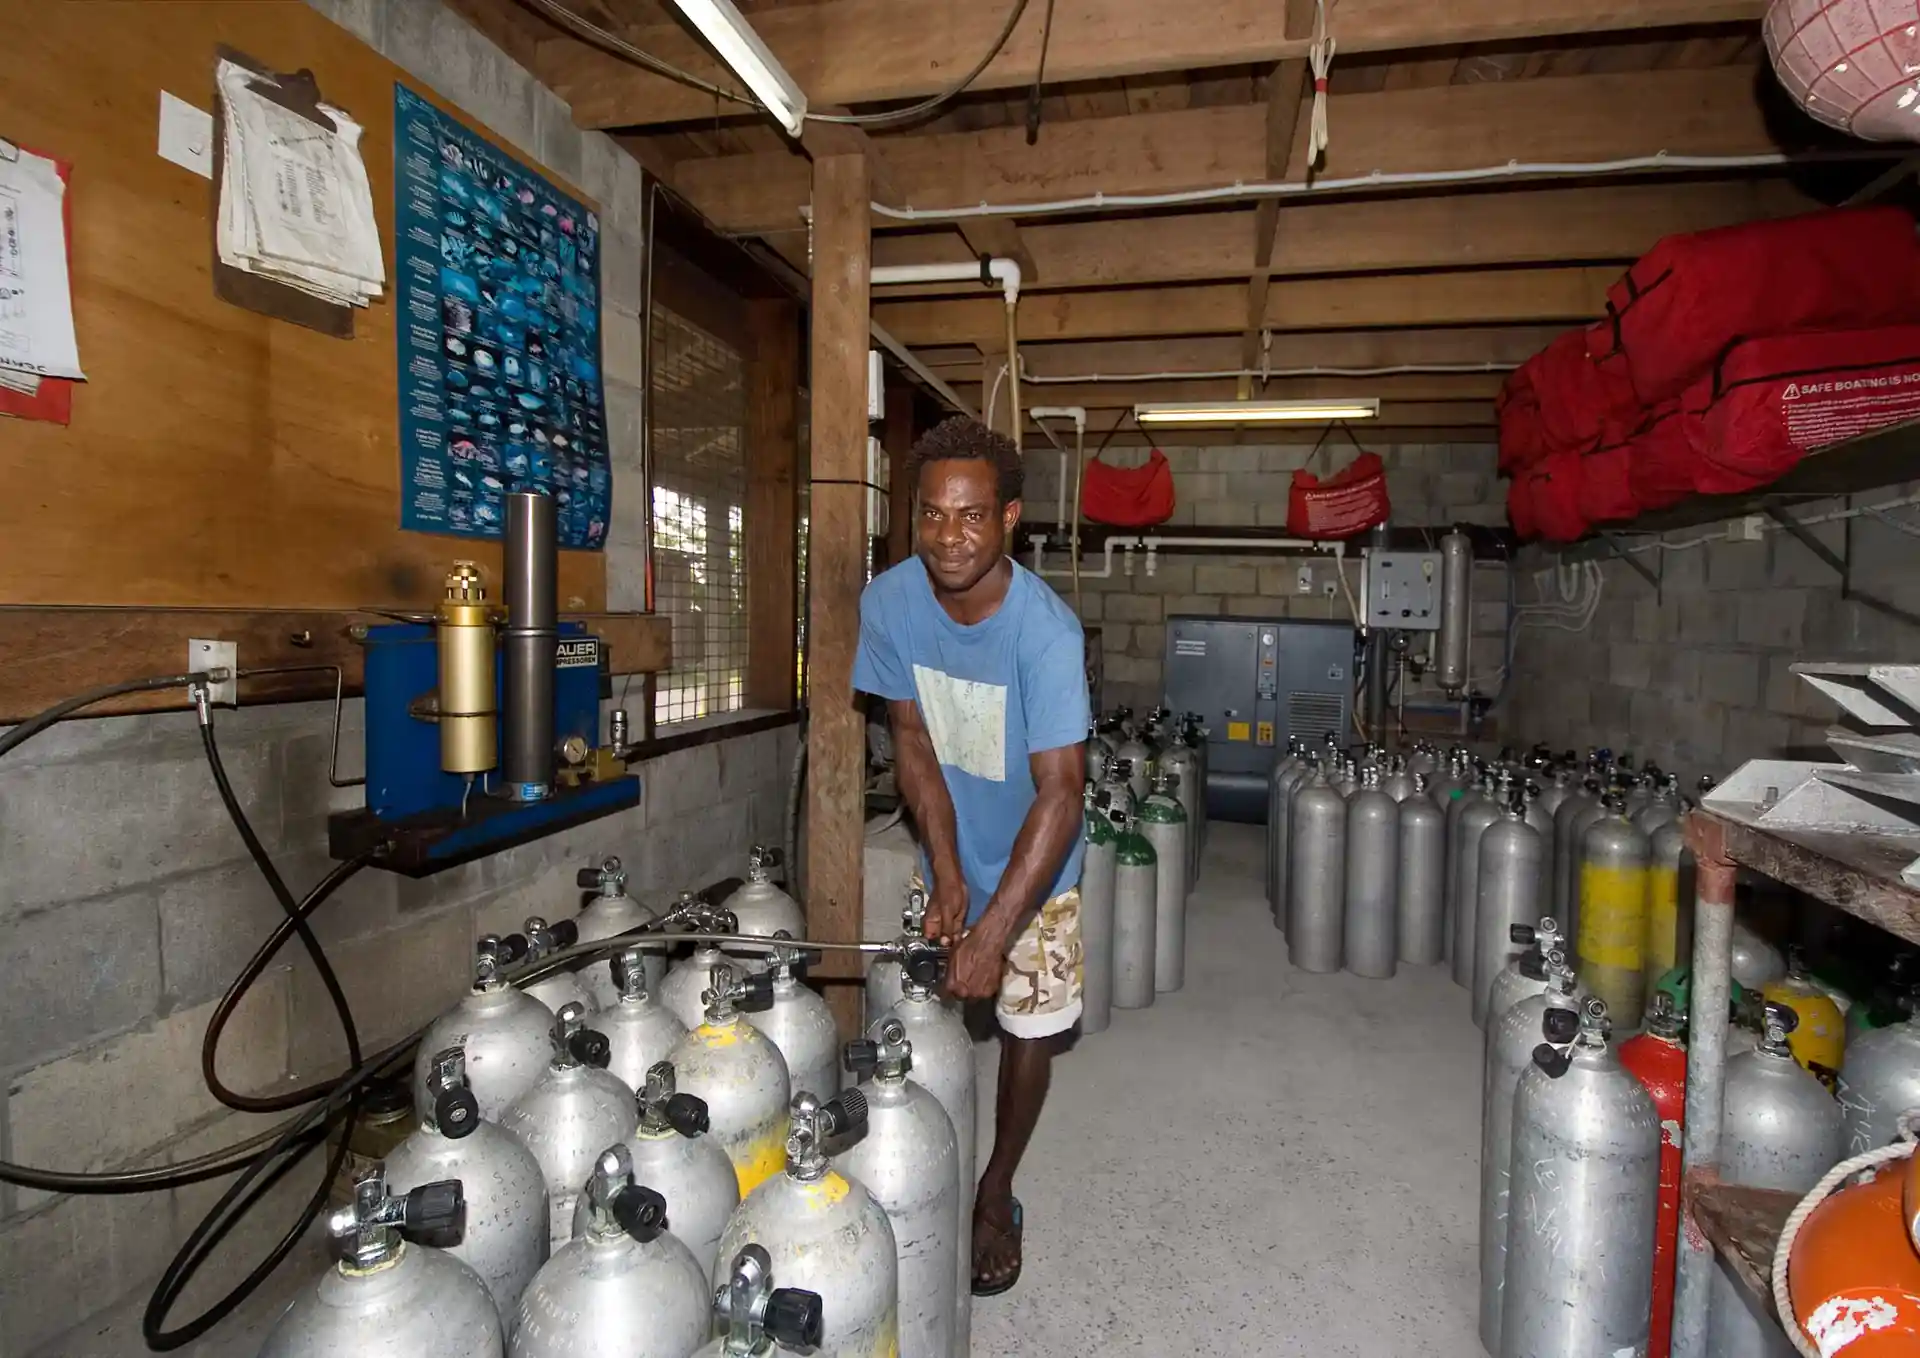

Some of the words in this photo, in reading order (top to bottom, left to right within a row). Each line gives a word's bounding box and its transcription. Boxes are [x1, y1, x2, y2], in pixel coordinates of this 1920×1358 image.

[1801, 382, 1832, 394] SAFE
[1835, 377, 1887, 391] BOATING
[1889, 375, 1902, 385] IS
[556, 643, 595, 656] AUER
